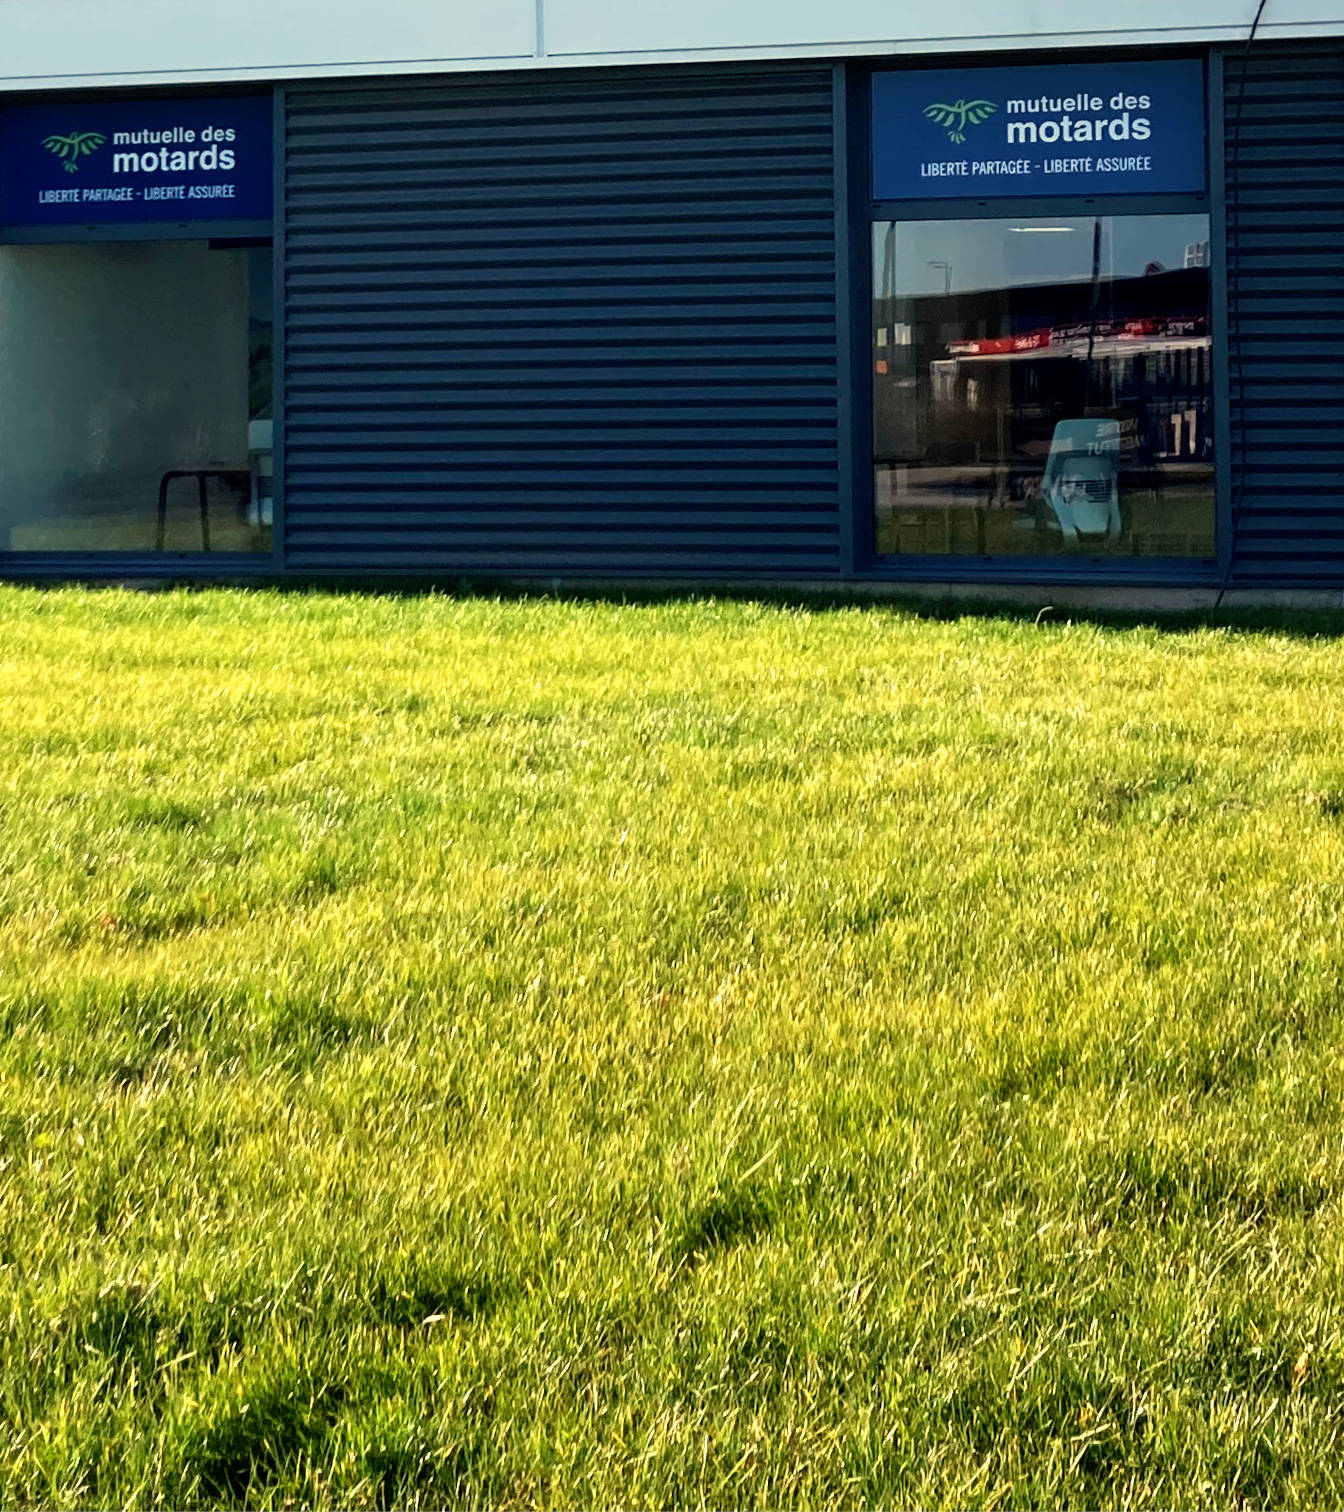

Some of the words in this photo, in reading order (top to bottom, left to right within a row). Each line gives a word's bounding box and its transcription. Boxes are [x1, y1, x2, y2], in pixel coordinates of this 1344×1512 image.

[1007, 94, 1103, 113] mutuelle
[1110, 92, 1151, 110] des
[113, 127, 196, 145] mutuelle
[201, 126, 236, 142] des
[1007, 112, 1151, 143] motards
[113, 145, 236, 173] motards
[921, 159, 968, 177] LIBERTÉ
[972, 158, 1031, 175] PARTAGÉE
[1044, 156, 1092, 173] LIBERTÉ
[1096, 155, 1152, 172] ASSURÉE
[39, 188, 80, 204] LIBERTÉ
[83, 186, 134, 202] PARTAGÉE
[144, 185, 185, 200] LIBERTÉ
[188, 184, 235, 198] ASSURÉE
